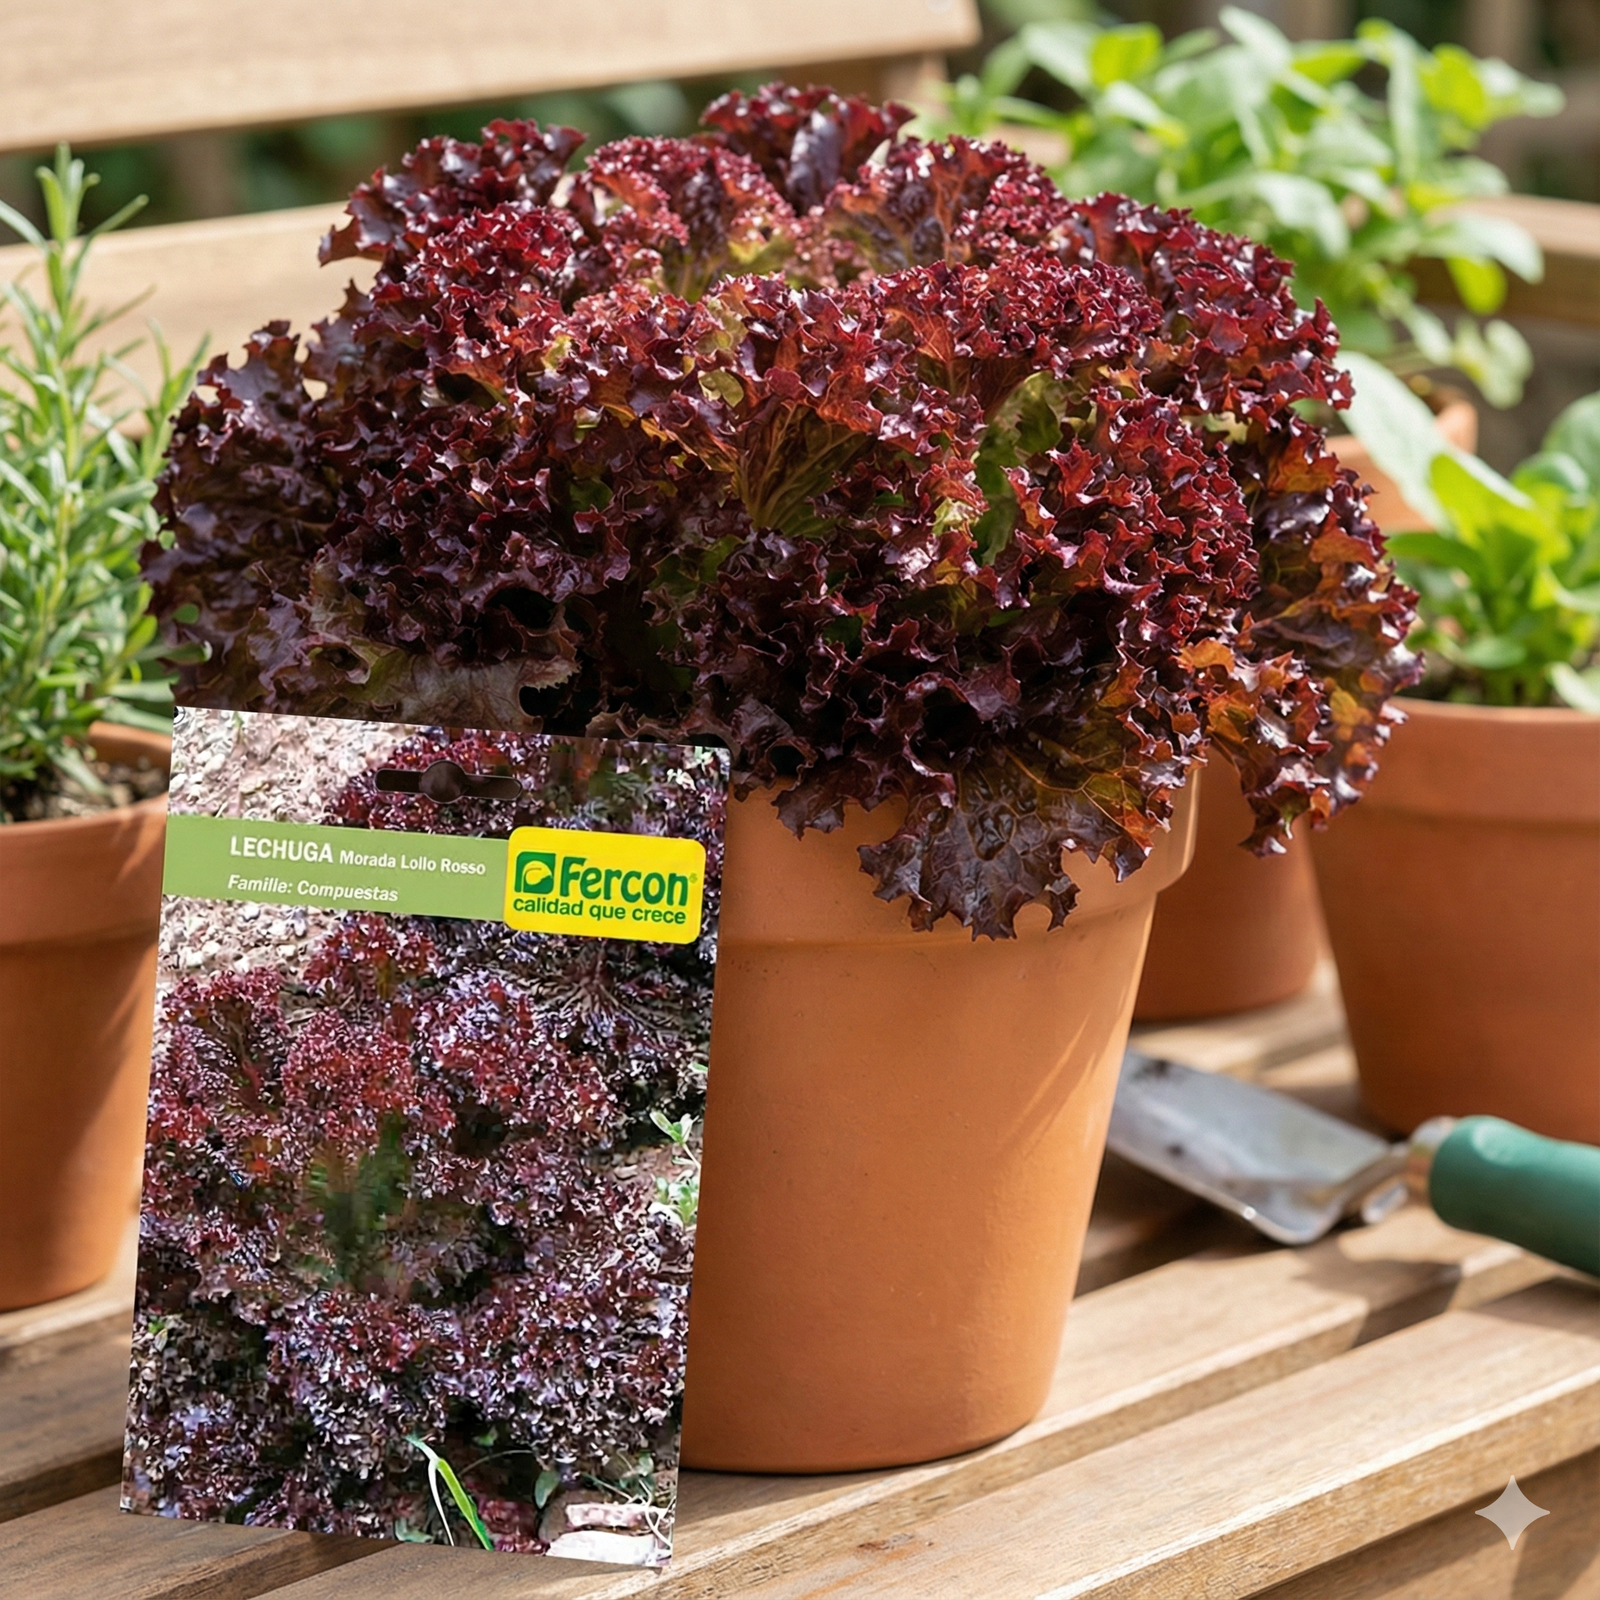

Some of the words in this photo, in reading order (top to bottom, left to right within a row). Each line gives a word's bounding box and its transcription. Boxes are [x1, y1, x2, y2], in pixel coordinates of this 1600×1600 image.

[229, 836, 334, 863] LECHUGA
[338, 850, 397, 868] Morada
[400, 855, 437, 871] Lollo
[440, 858, 487, 876] Rosso
[296, 880, 399, 902] Compuestas
[559, 856, 689, 907] Fercon
[513, 897, 584, 917] calidad
[589, 905, 627, 922] que
[631, 908, 687, 925] crece
